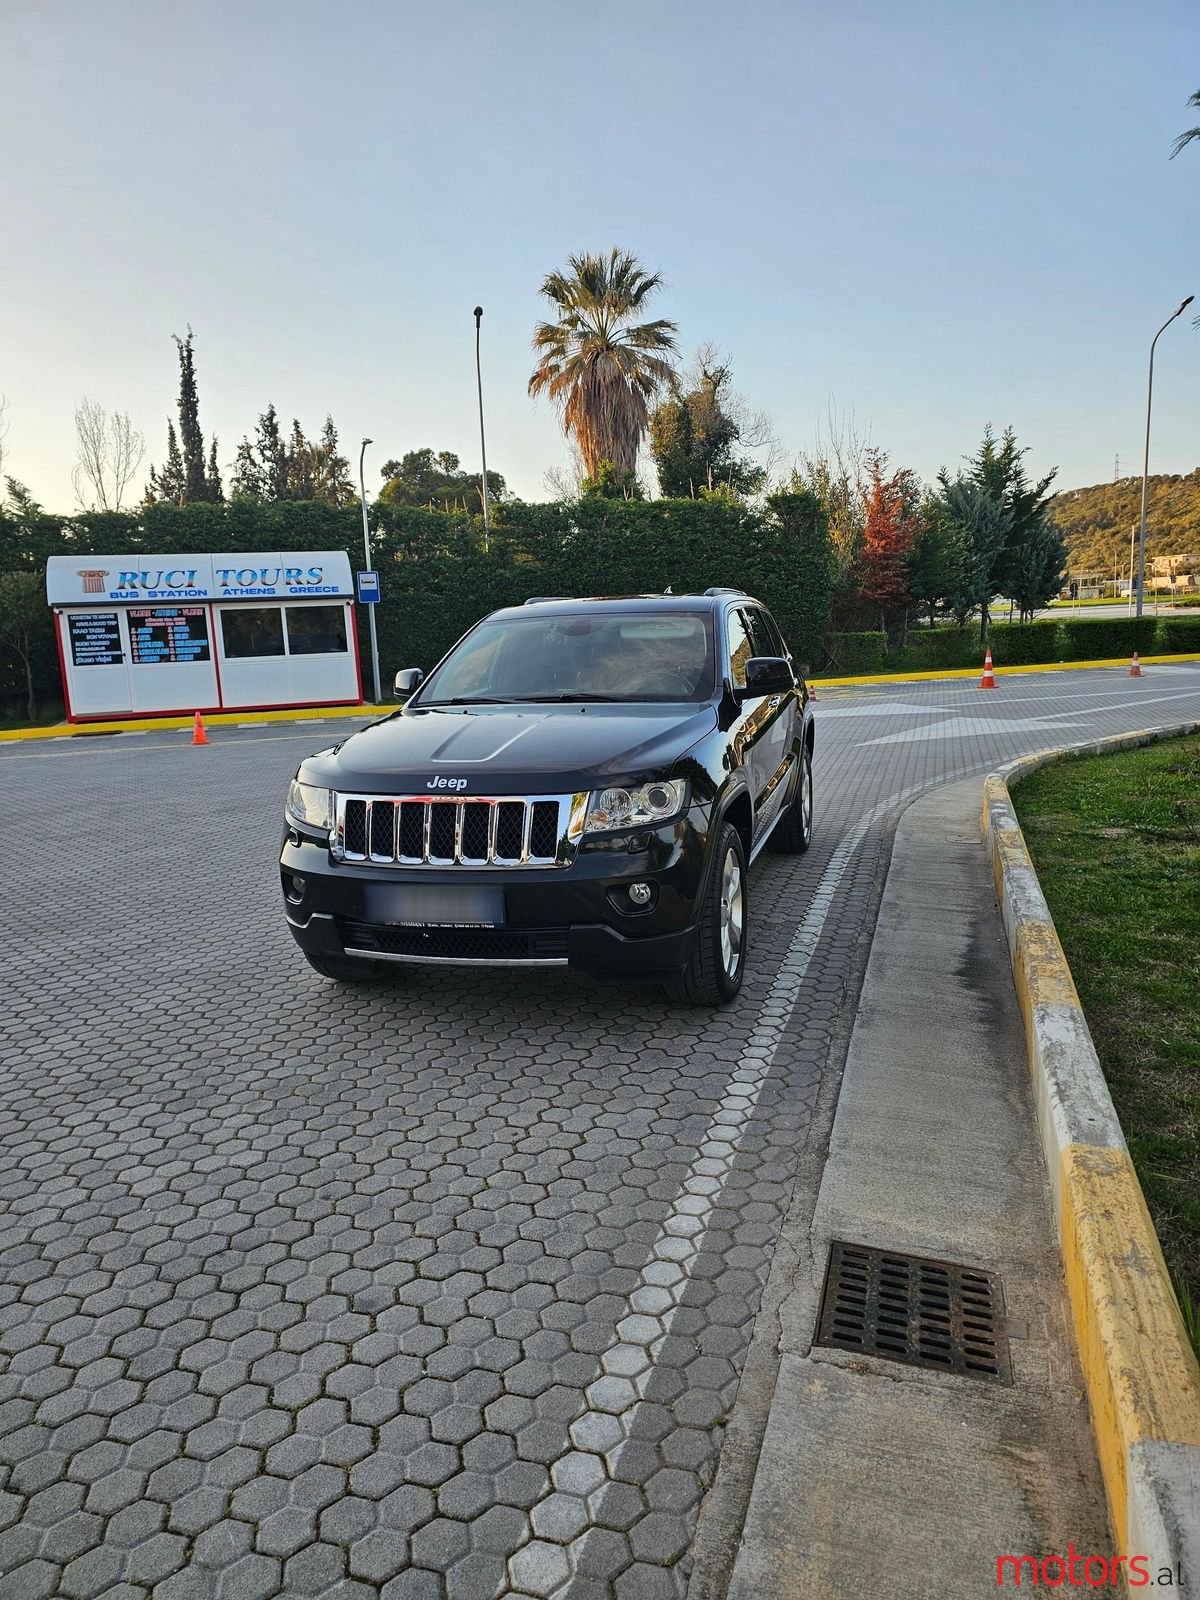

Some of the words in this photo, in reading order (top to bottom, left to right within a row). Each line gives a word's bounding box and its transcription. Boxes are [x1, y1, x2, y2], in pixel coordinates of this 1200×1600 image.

[117, 570, 198, 589] RUCI
[215, 567, 324, 588] TOURS
[148, 590, 207, 598] STATION
[222, 587, 276, 595] ATHENS
[289, 585, 340, 593] GREECE
[427, 776, 468, 791] Jeep
